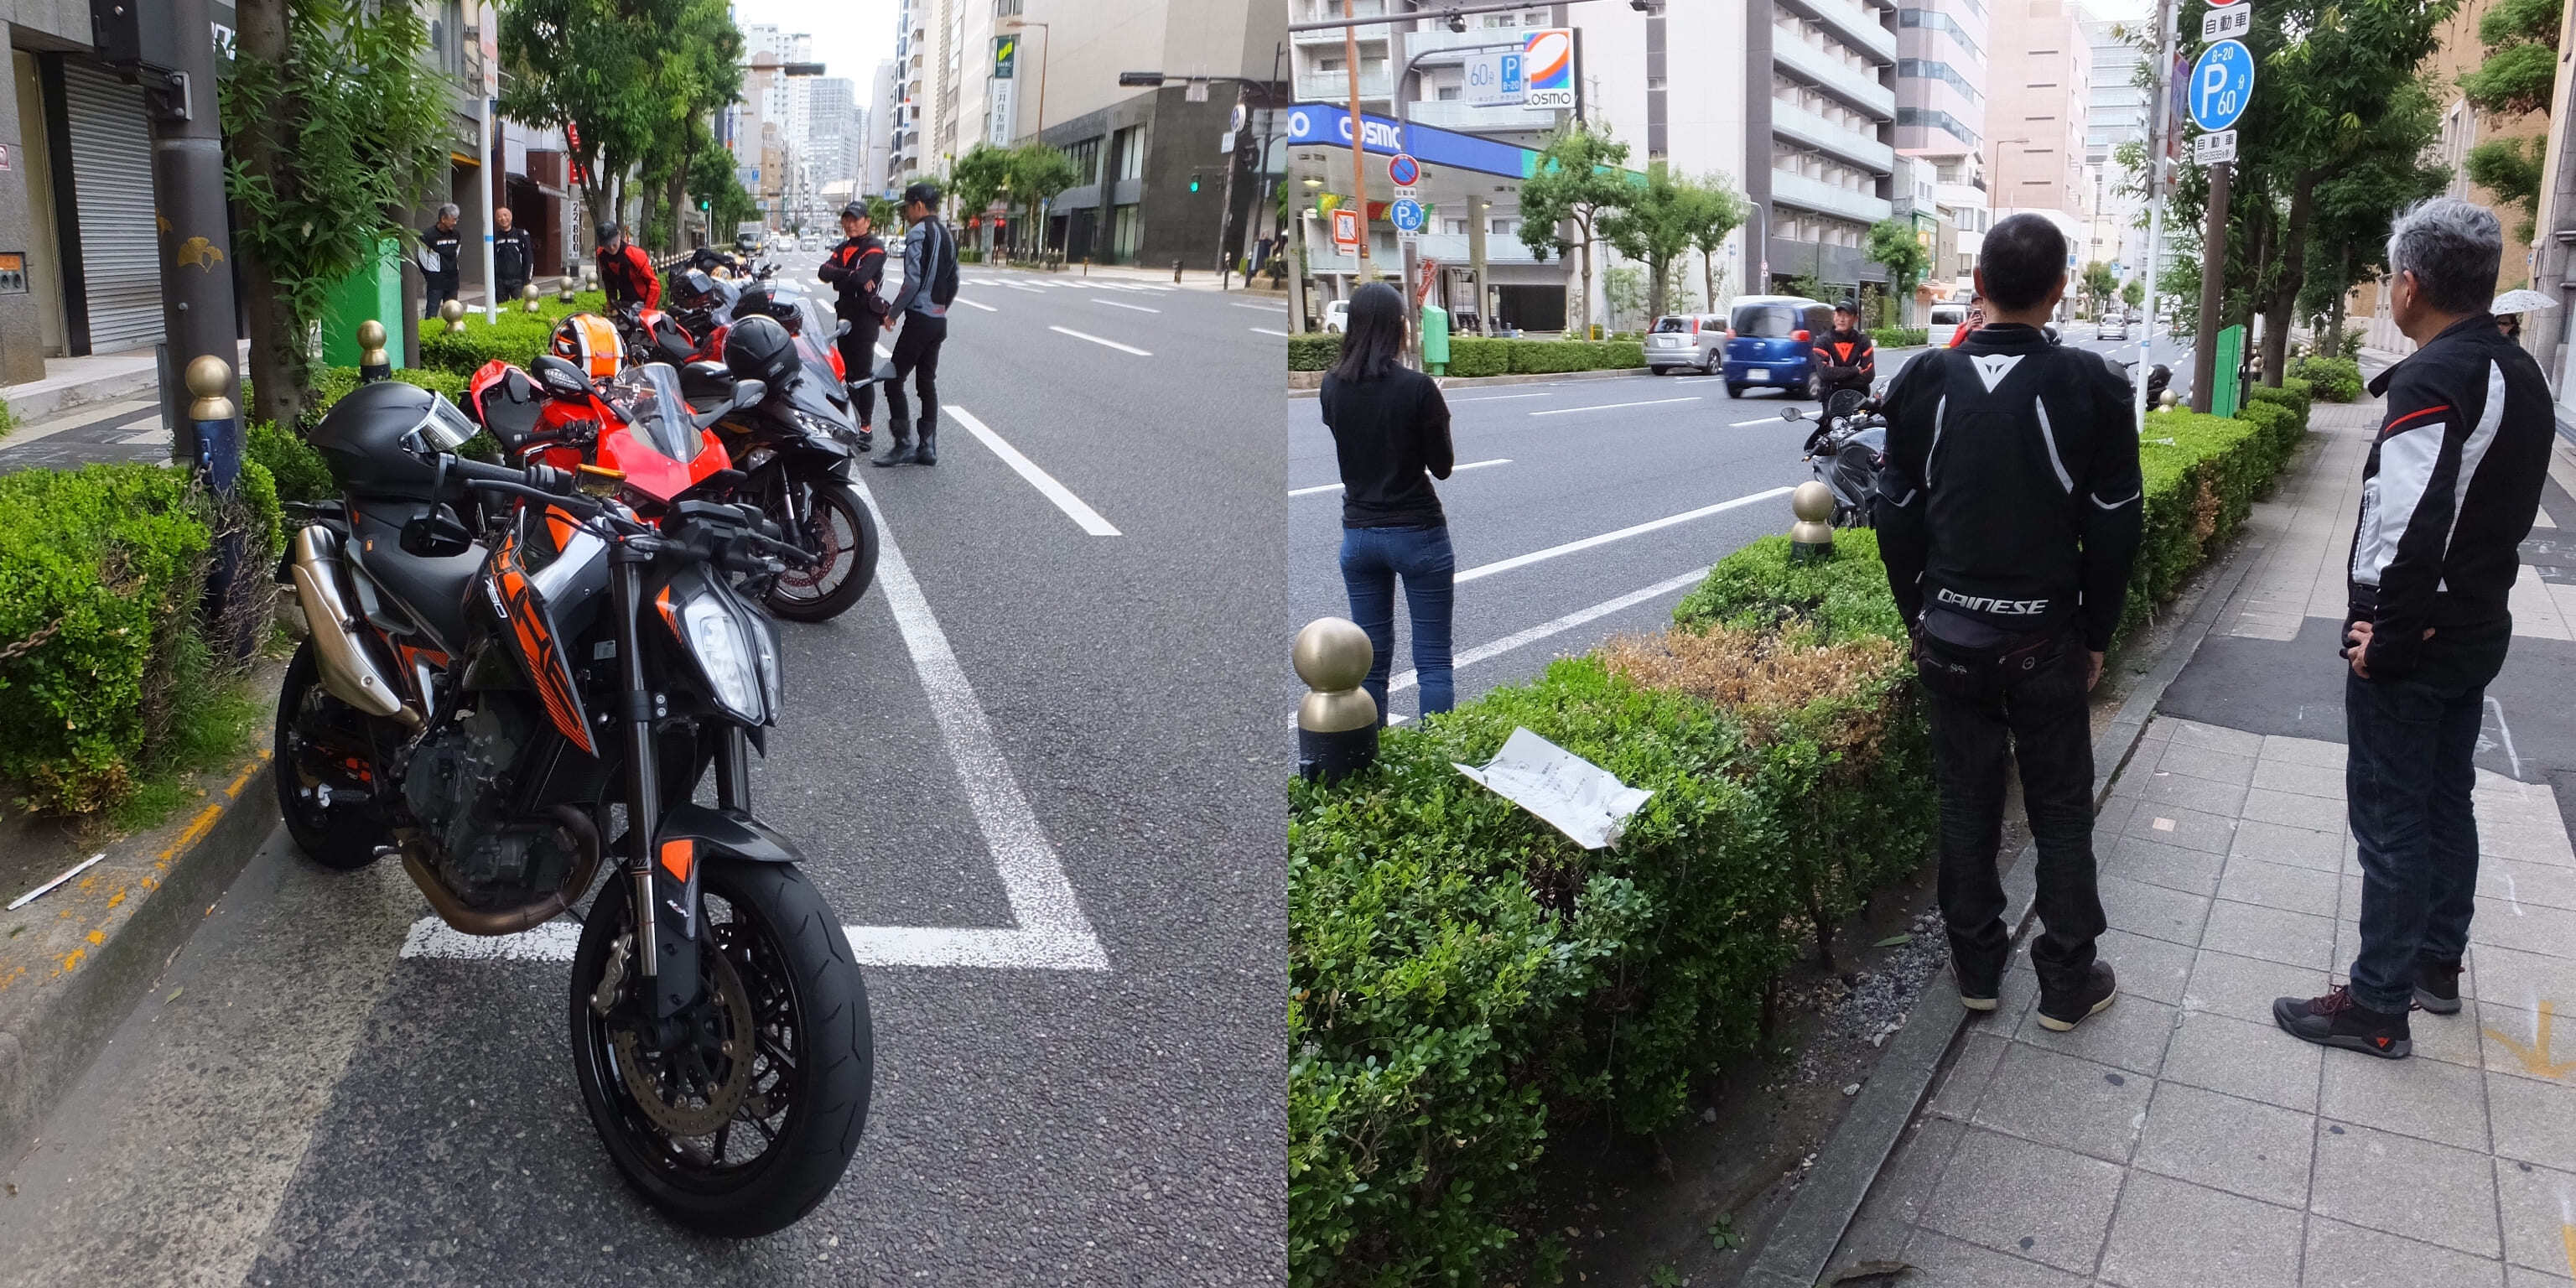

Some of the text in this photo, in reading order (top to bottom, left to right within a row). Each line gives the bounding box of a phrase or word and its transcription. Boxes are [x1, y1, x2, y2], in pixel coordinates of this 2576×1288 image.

[2205, 12, 2246, 34] 自動車
[2212, 46, 2233, 63] 8-20
[1506, 57, 1517, 79] P
[1527, 92, 1571, 106] OSMO
[2201, 63, 2227, 118] P
[2197, 133, 2234, 150] 自動車
[1937, 588, 2049, 615] DAINESE
